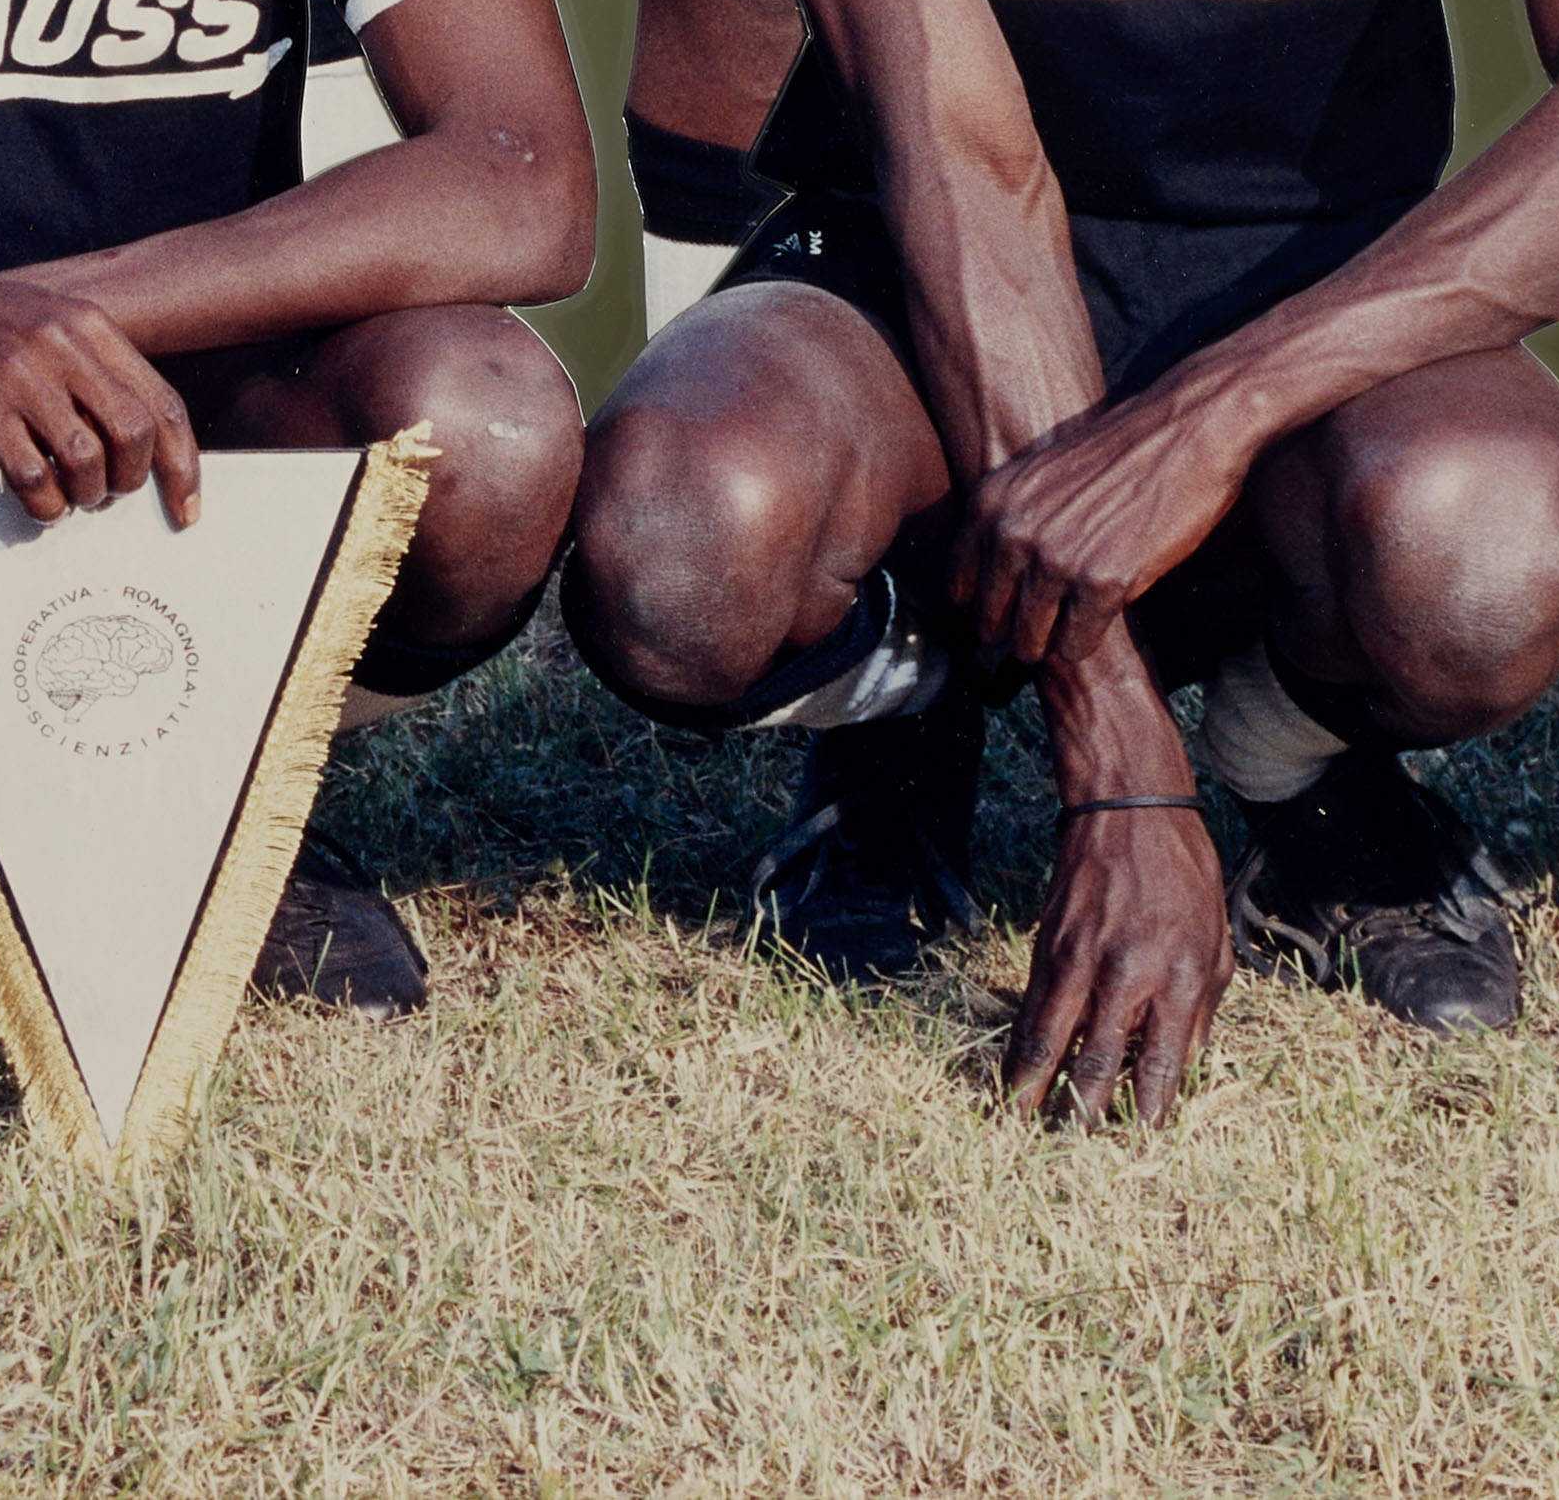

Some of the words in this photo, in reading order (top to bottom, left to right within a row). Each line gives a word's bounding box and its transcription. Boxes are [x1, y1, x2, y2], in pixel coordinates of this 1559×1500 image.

[13, 586, 92, 703] COOPERATIVA
[122, 585, 200, 693] ROMAGNOLA
[28, 701, 190, 757] SCIENZIATI
